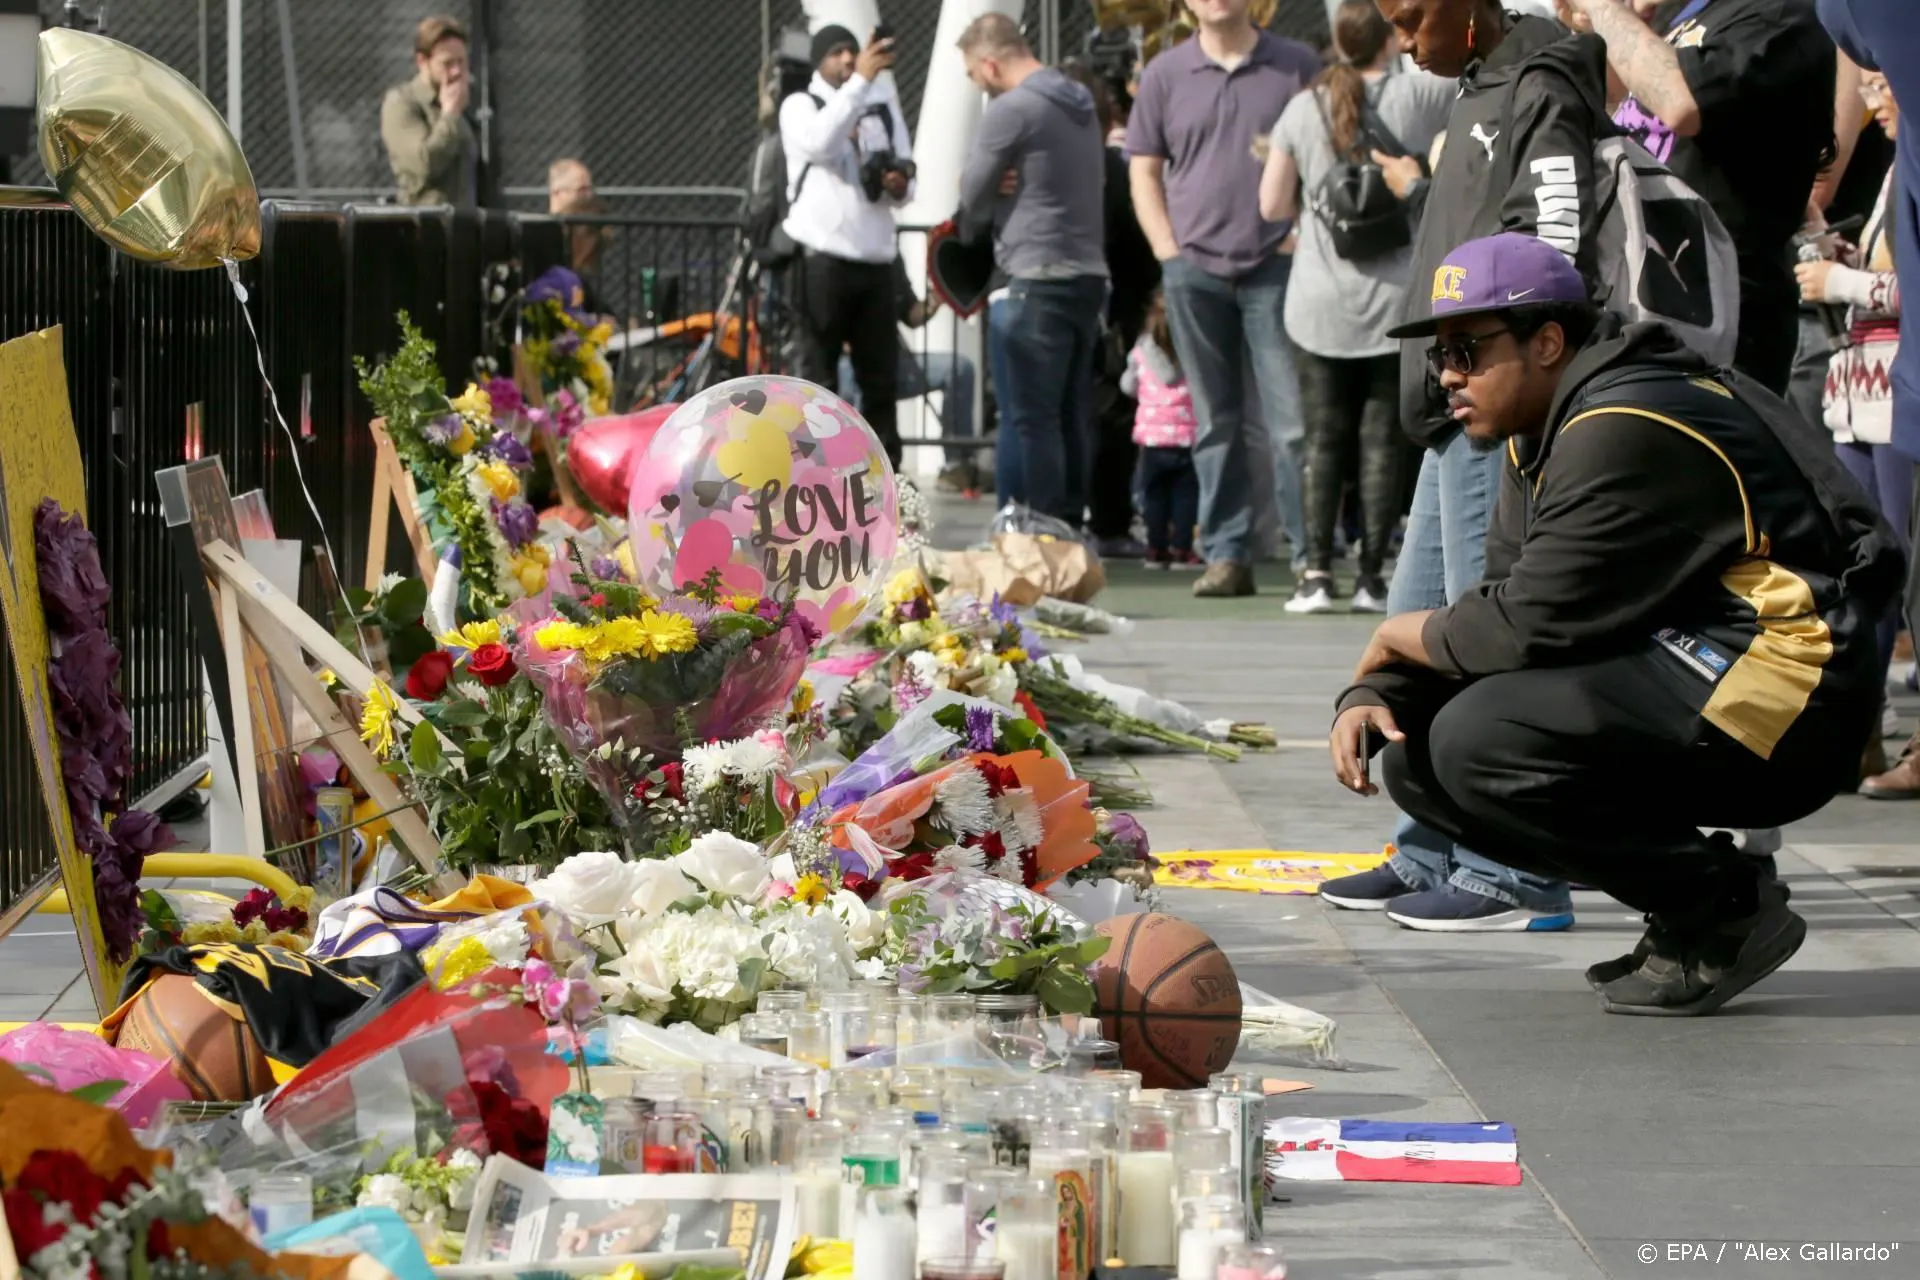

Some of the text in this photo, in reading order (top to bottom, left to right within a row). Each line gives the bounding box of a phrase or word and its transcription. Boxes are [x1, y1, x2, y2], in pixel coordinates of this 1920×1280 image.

[1530, 155, 1580, 265] PUM
[743, 468, 878, 546] LOVE
[1674, 635, 1696, 652] XL
